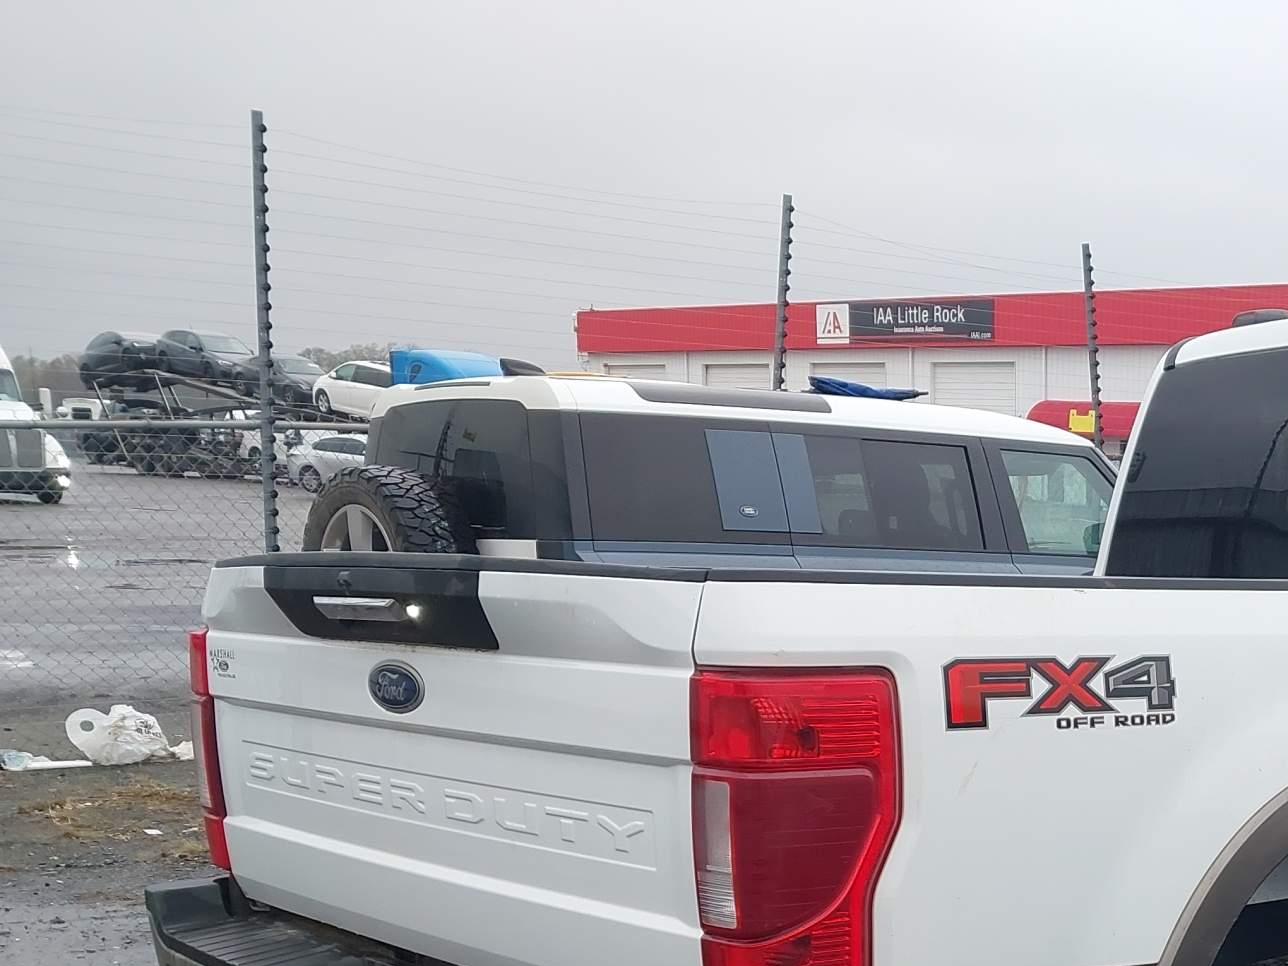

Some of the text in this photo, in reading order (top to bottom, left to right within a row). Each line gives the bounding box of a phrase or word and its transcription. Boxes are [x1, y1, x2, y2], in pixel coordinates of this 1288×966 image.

[873, 304, 965, 325] IAA Little Rock
[376, 671, 405, 701] Ford
[941, 654, 1177, 732] FX4
[1056, 712, 1176, 729] OFF ROAD
[248, 750, 646, 854] SUPER DUTY
